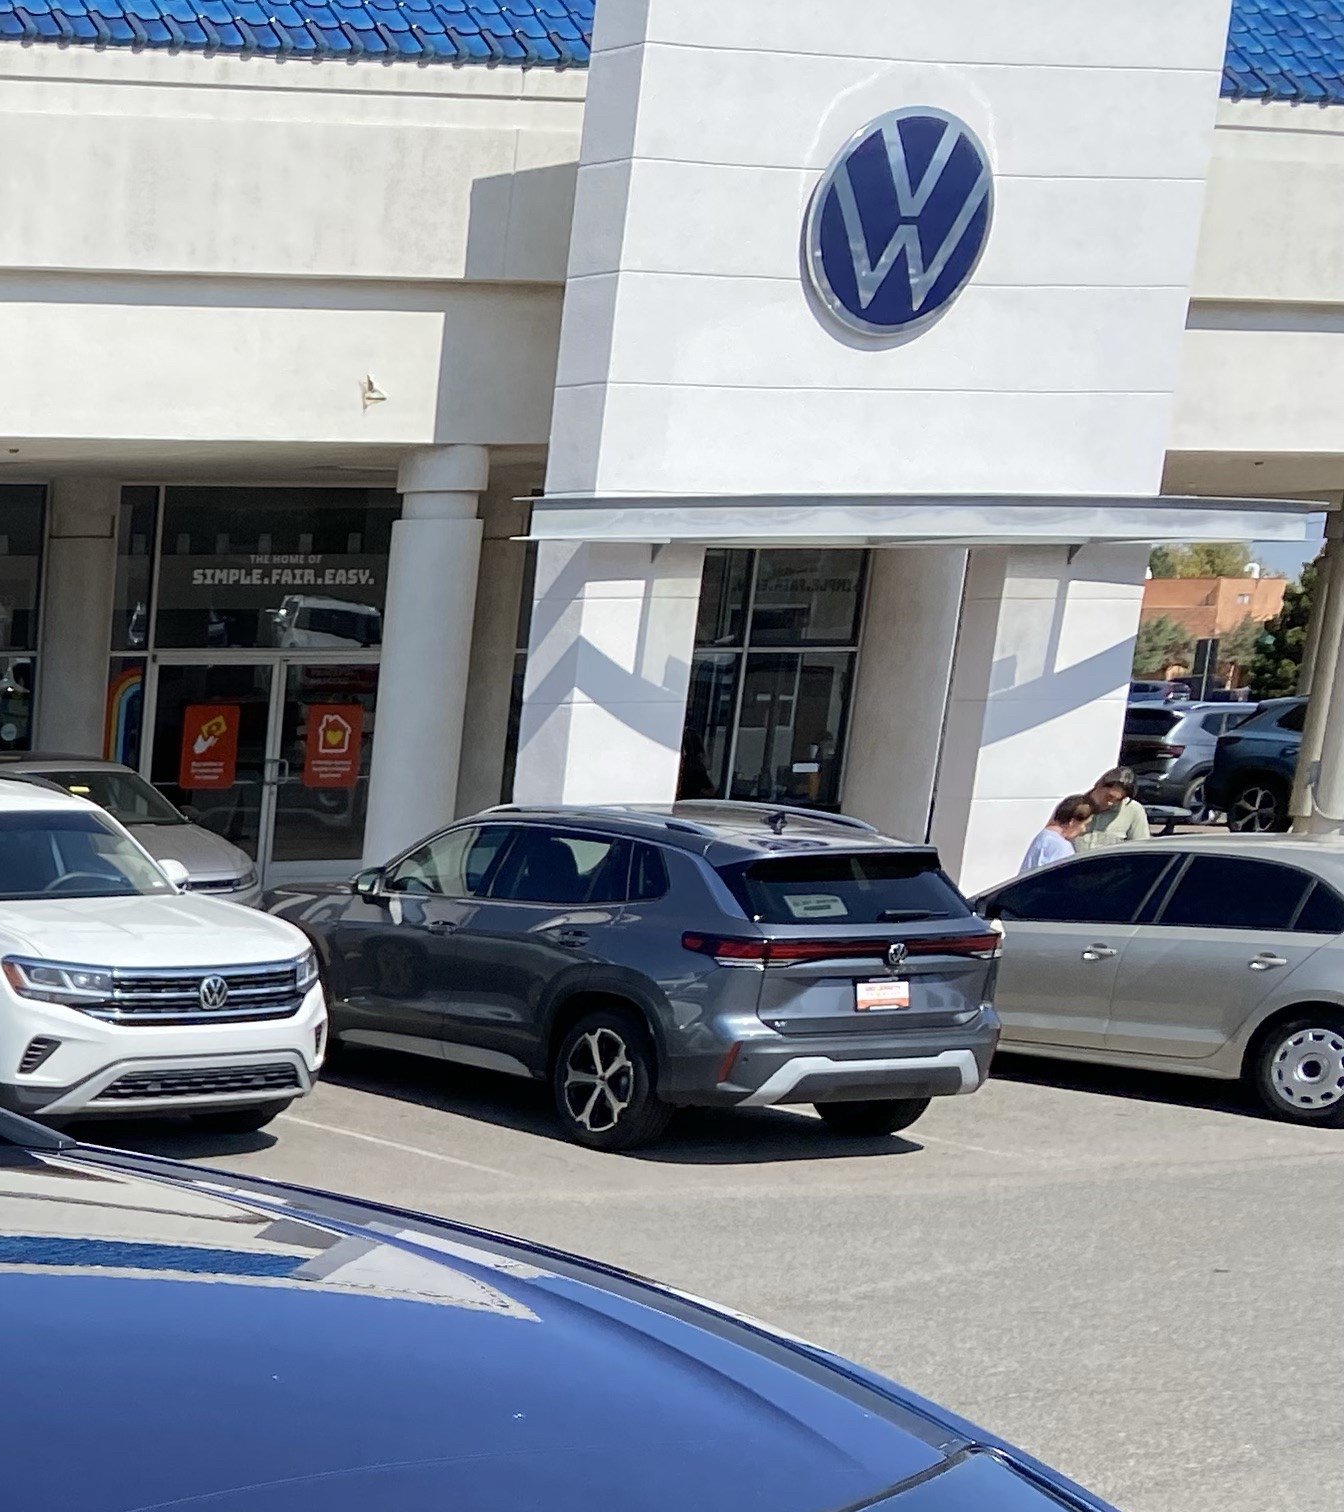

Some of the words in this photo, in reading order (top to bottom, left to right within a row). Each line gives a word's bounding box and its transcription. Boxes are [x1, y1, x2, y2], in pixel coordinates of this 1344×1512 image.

[820, 112, 993, 325] VW
[250, 555, 270, 564] THE
[273, 555, 304, 564] HOME
[308, 555, 322, 564] OF
